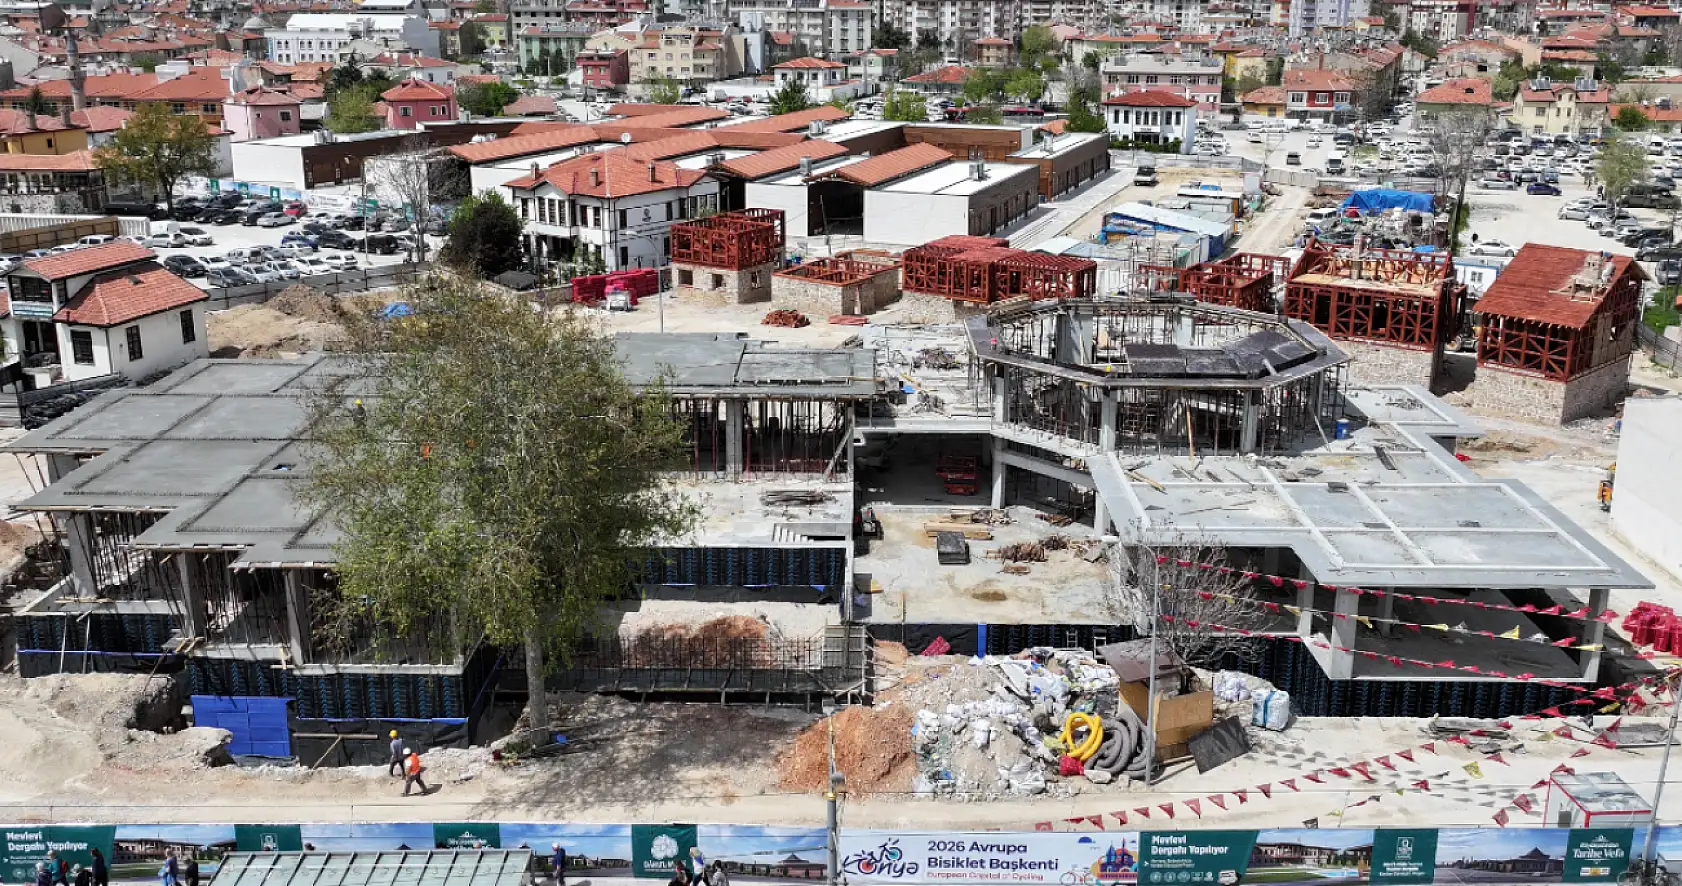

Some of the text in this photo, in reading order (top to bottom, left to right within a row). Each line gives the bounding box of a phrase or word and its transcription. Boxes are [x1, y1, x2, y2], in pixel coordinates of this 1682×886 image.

[927, 841, 1027, 855] 2026 Avrupa
[927, 857, 1059, 872] Bisiklet Başkenti
[926, 871, 967, 880] European
[1011, 872, 1044, 882] Cycling
